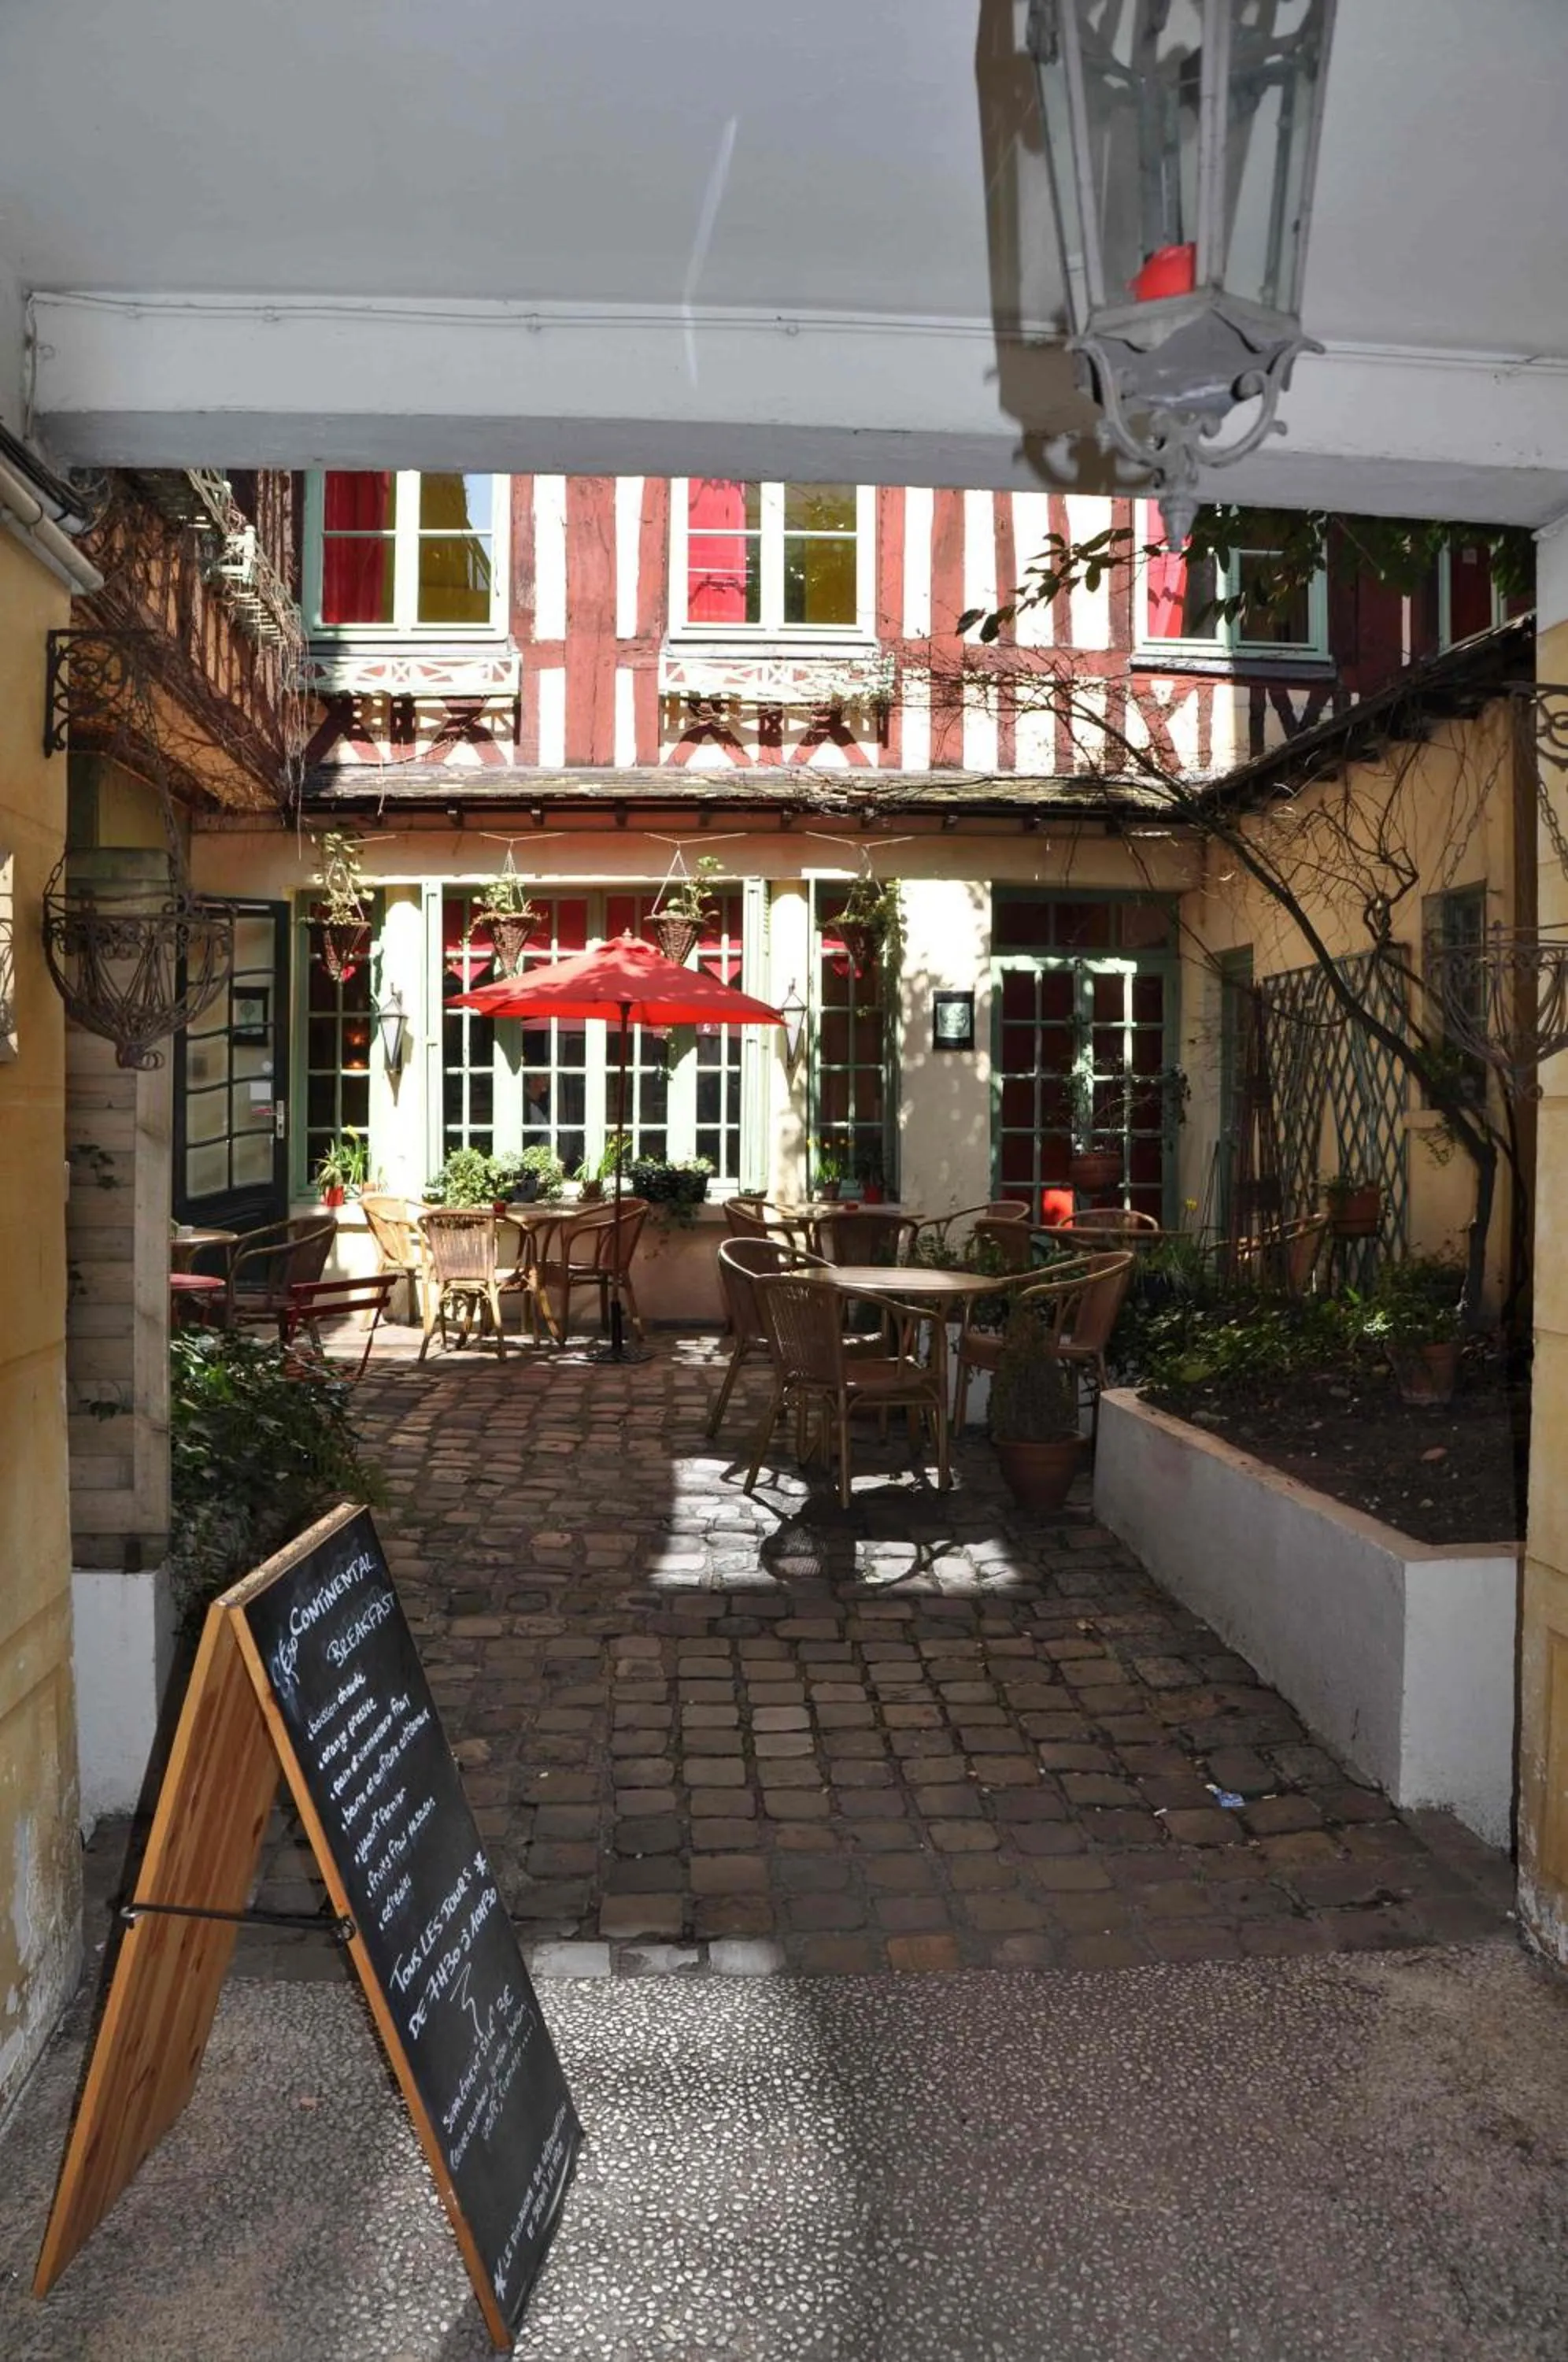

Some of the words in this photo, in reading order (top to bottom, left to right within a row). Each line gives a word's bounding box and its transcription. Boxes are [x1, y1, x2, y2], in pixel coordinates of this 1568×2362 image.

[289, 1552, 375, 1636] CONTINENTAL
[326, 1593, 394, 1668] BREAKFAST
[321, 1730, 349, 1764] orange
[390, 1947, 423, 1993] TOUS
[420, 1916, 444, 1957] LES
[440, 1867, 472, 1922] JOURS
[409, 1997, 427, 2040] DE
[425, 1946, 461, 2001] 7H30
[469, 1887, 497, 1938] 10H30
[496, 1984, 514, 2016] 3€
